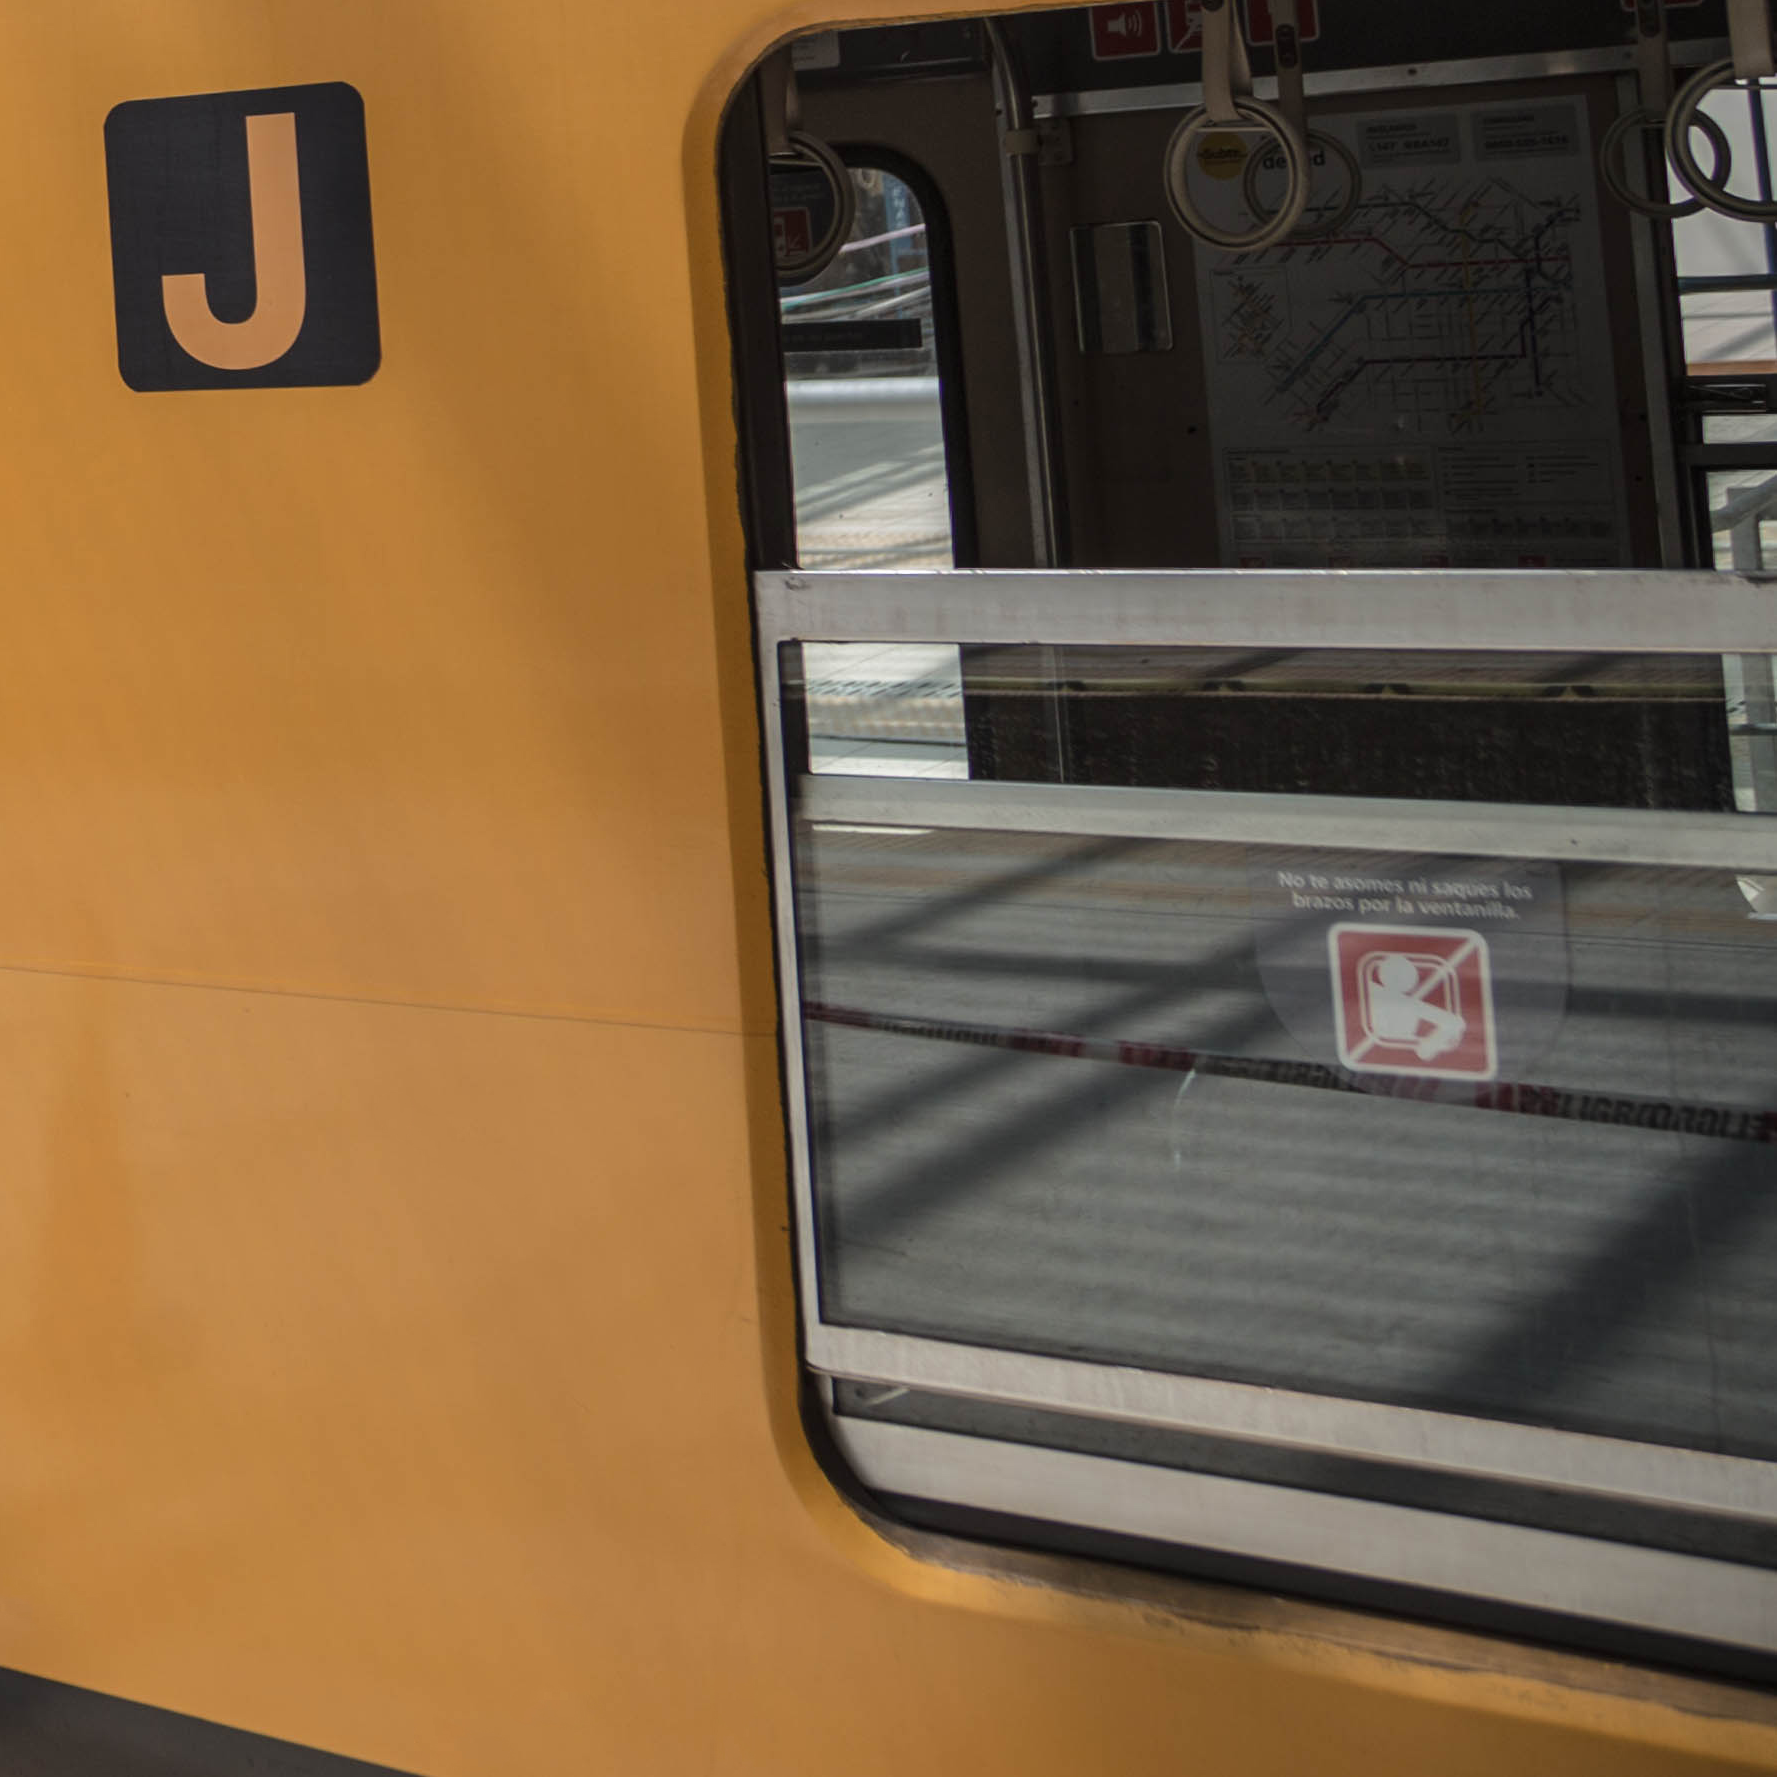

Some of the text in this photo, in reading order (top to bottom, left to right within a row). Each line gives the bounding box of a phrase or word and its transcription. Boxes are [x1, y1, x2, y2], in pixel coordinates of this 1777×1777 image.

[161, 112, 306, 370] J
[1277, 871, 1533, 900] No te asomes ni saques los
[1292, 892, 1353, 911] brazos
[1358, 896, 1391, 915] por
[1396, 897, 1414, 915] la
